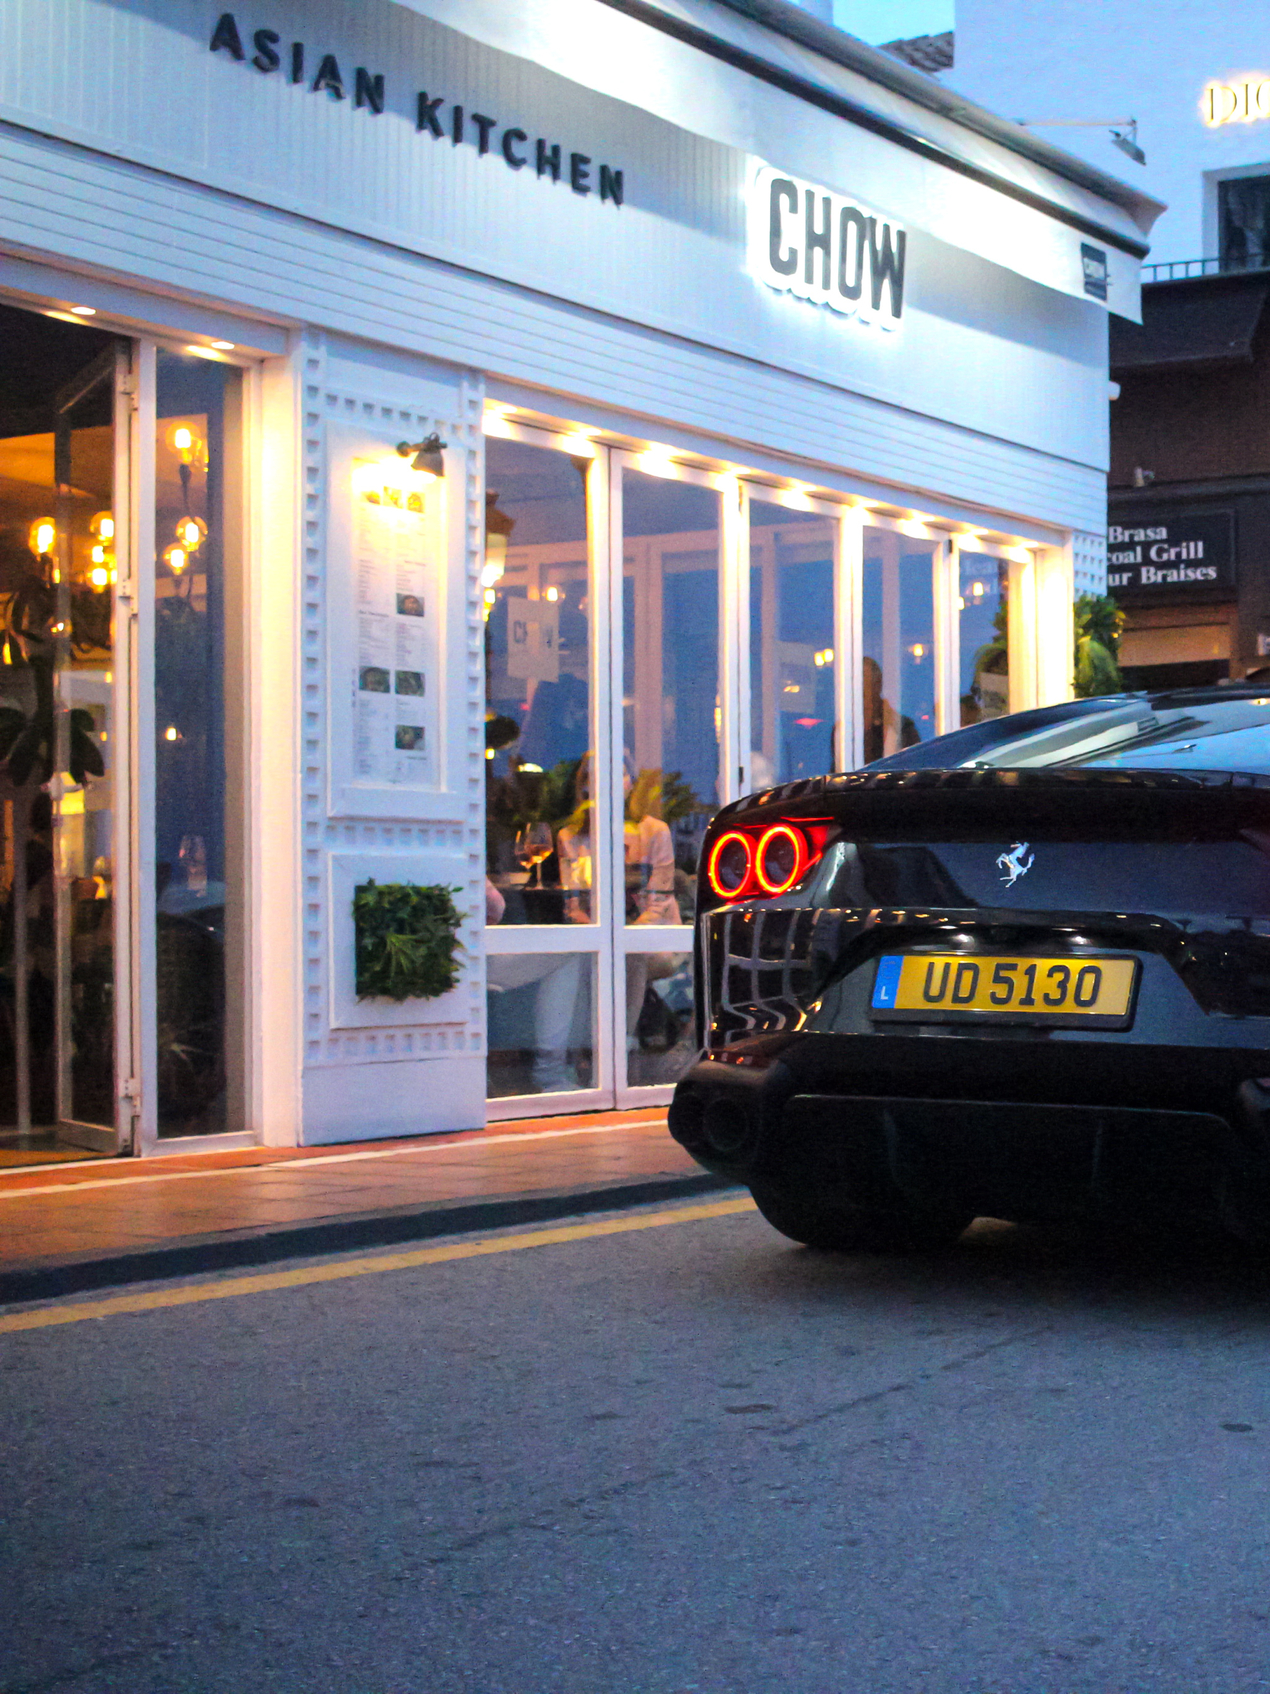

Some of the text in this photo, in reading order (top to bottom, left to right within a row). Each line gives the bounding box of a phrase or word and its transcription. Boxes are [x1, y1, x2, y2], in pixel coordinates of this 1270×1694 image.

[209, 13, 624, 206] ASIAN KITCHEN
[769, 178, 906, 319] CHOW
[1108, 525, 1168, 544] Brasa
[1149, 540, 1204, 563] Grill
[1141, 563, 1217, 585] Braises
[880, 986, 889, 1000] L
[923, 961, 1103, 1008] UD 5130
